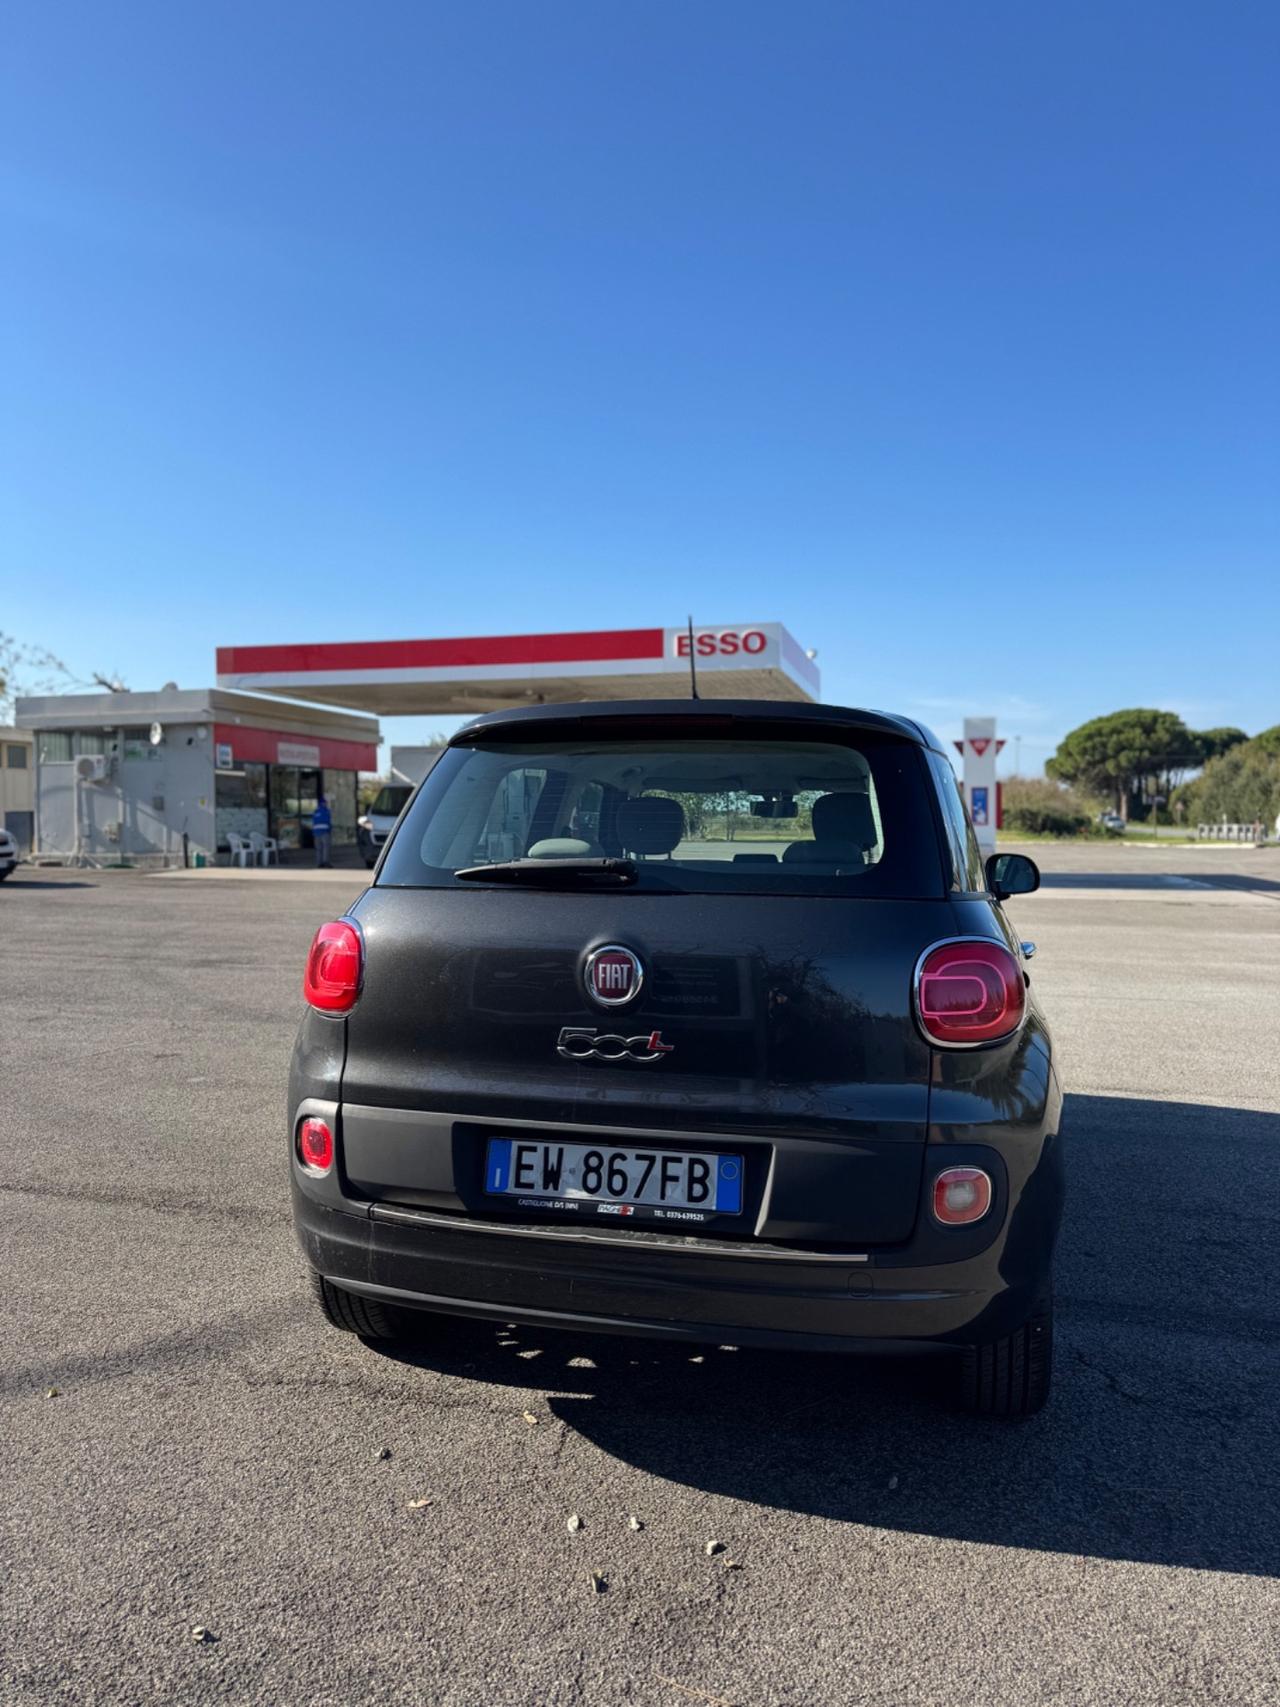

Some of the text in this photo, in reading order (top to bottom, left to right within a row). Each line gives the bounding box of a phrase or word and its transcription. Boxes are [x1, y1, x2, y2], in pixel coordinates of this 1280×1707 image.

[676, 631, 767, 657] ESSO
[598, 963, 631, 989] FIAT
[556, 1027, 675, 1063] 500L
[514, 1145, 710, 1204] EW 867FB
